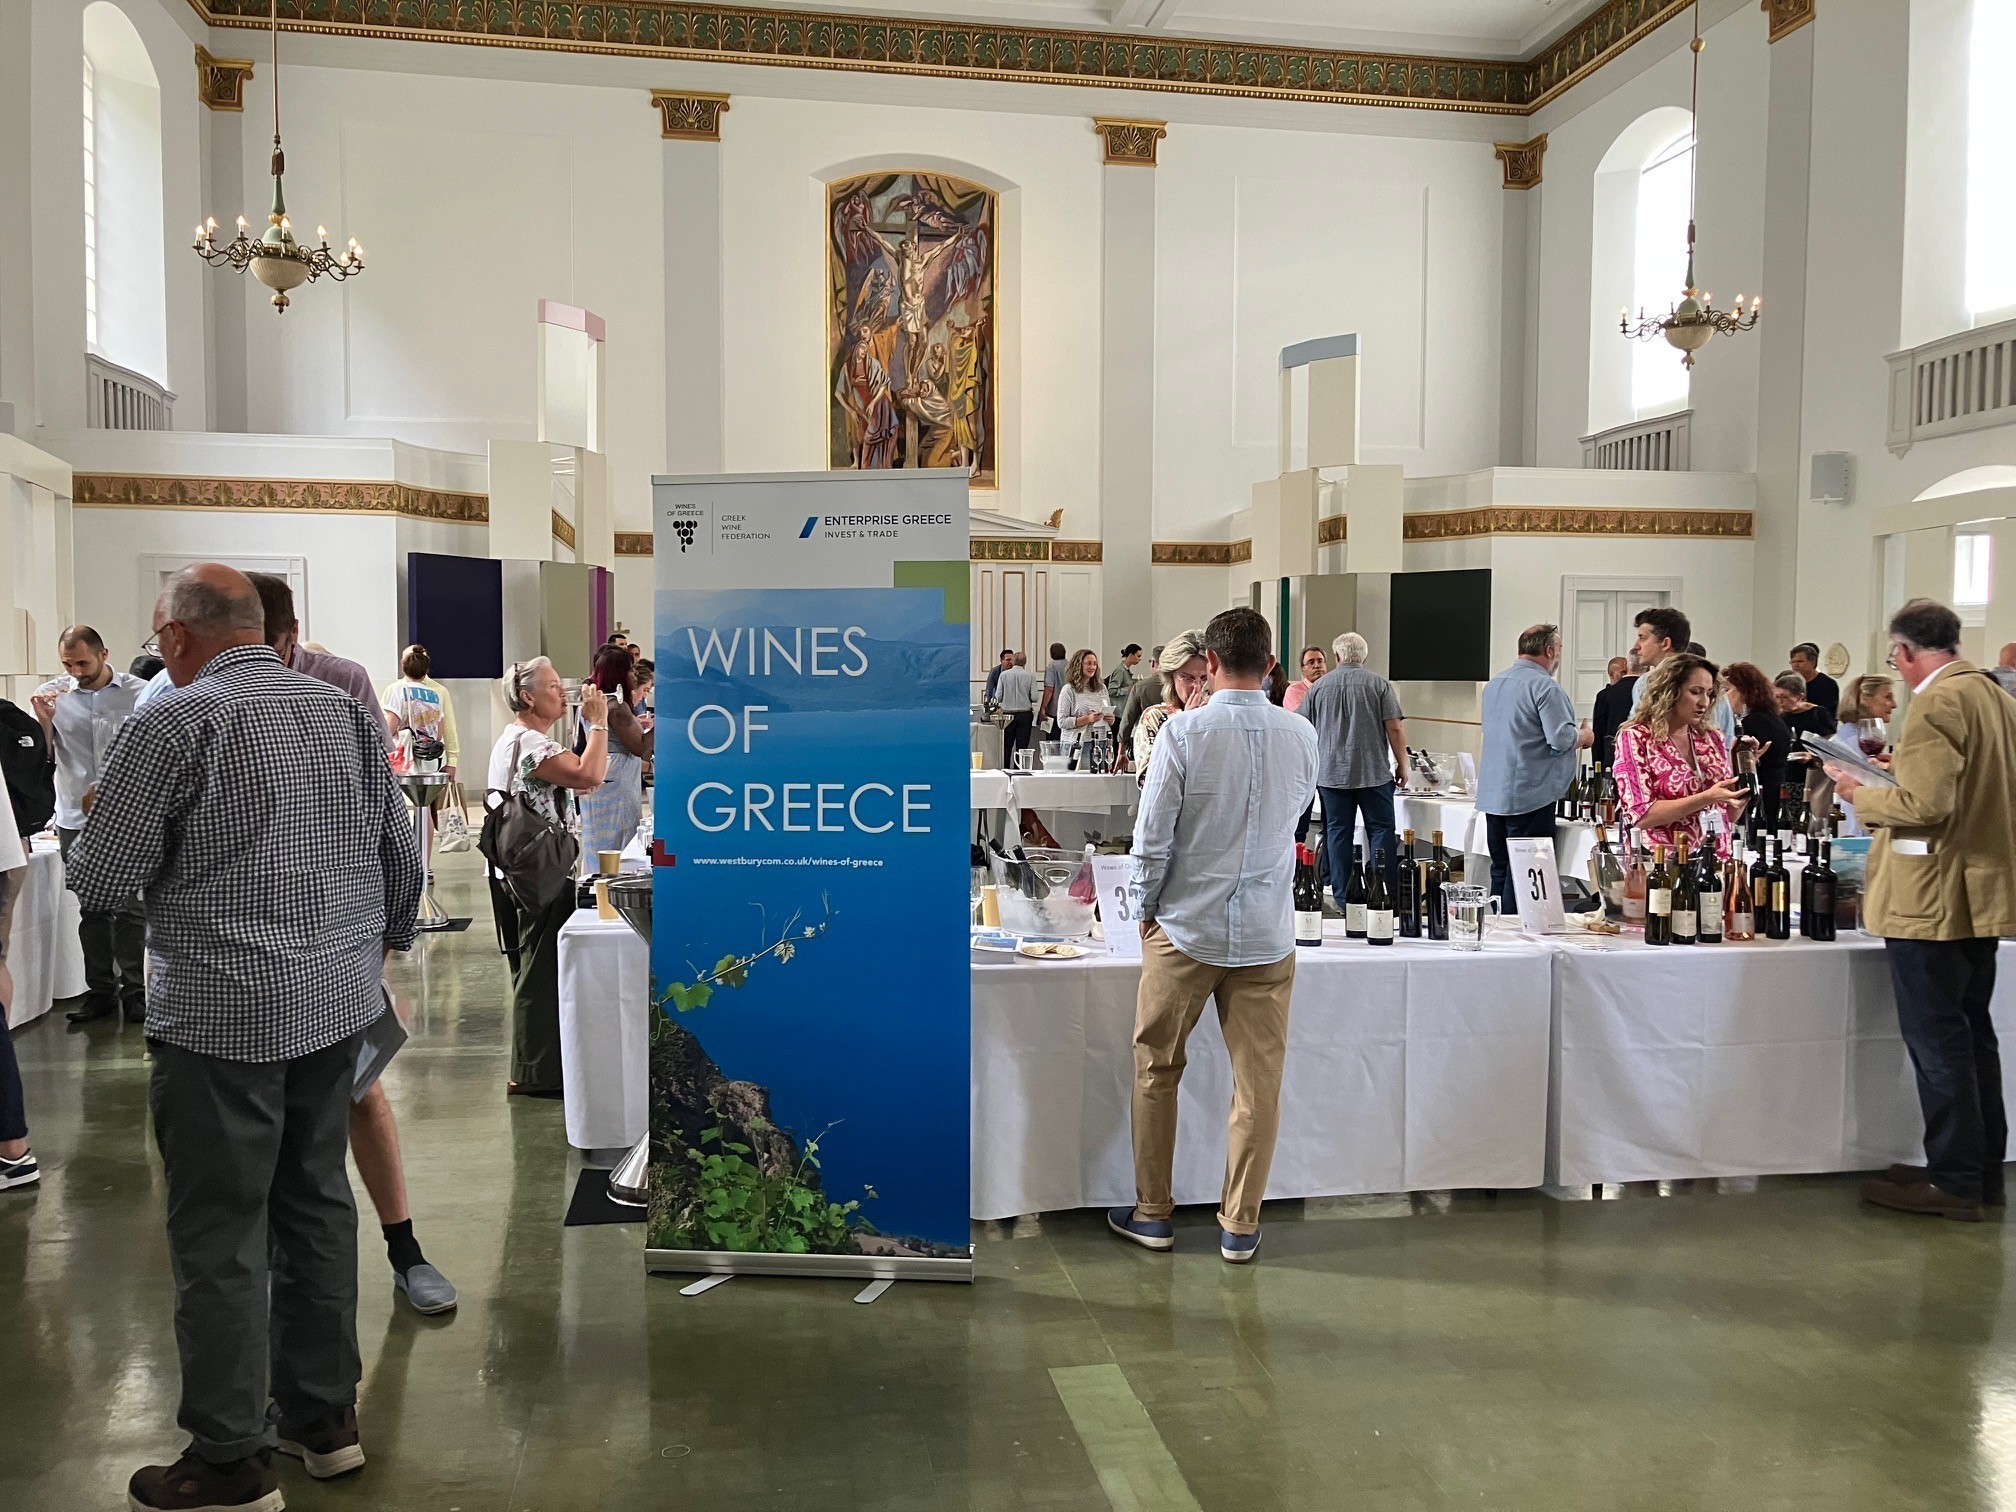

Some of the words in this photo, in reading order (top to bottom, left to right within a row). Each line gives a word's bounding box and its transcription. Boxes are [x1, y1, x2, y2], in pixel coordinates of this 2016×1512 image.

[824, 515, 899, 526] ENTERPRISE
[902, 514, 952, 525] GREECE
[867, 530, 899, 538] TRADE
[687, 625, 869, 677] WINES
[687, 704, 769, 755] OF
[687, 781, 931, 834] GREECE
[693, 856, 884, 868] www.westburycom.co.uk/wines-of-greece
[1528, 868, 1548, 901] 31
